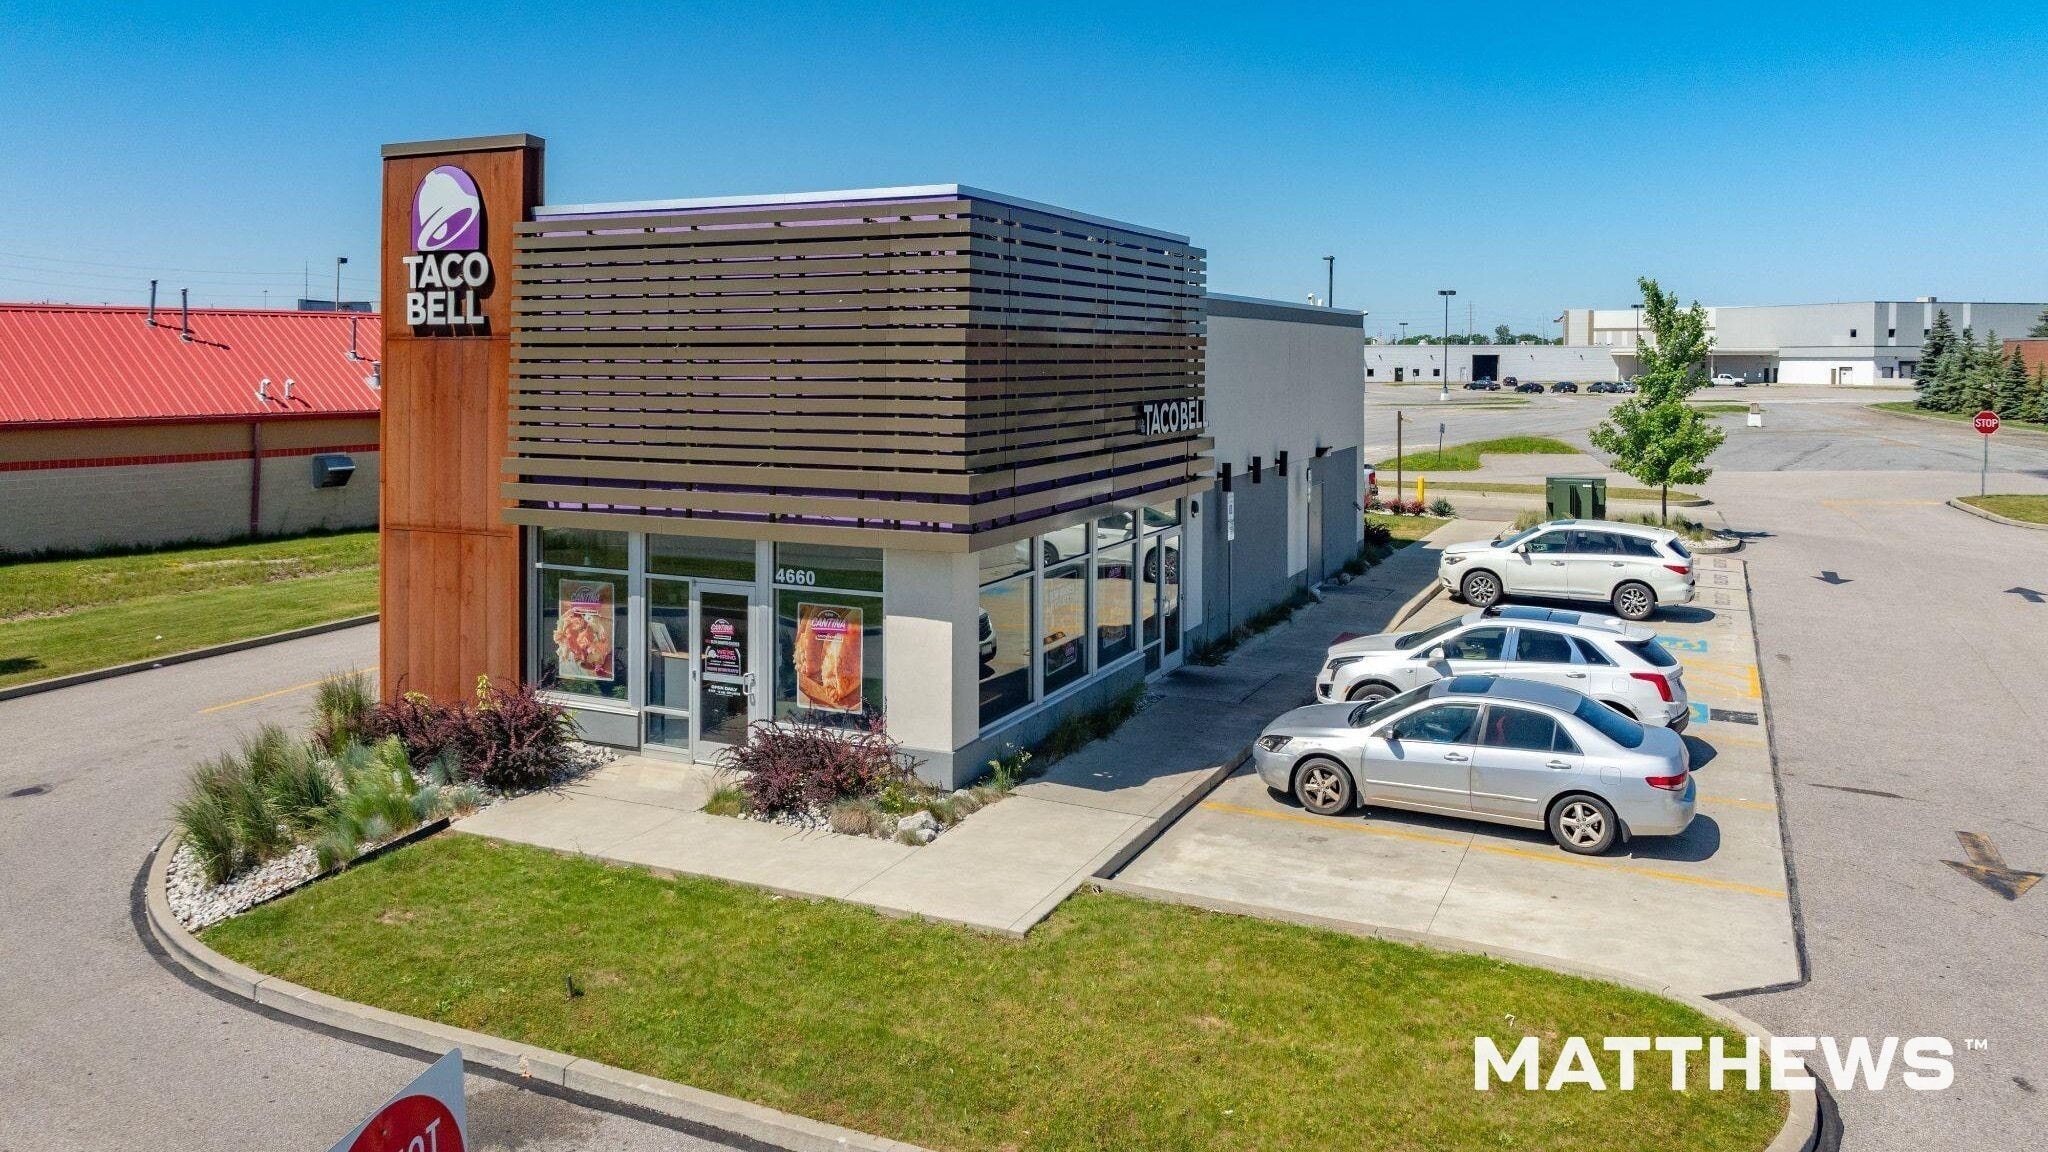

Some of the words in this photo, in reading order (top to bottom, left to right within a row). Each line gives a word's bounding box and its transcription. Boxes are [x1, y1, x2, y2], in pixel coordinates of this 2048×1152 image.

[403, 252, 489, 289] TACO
[407, 290, 484, 326] BELL
[1975, 418, 1998, 428] STOP
[775, 568, 816, 586] 4660
[811, 617, 847, 630] CANTINA
